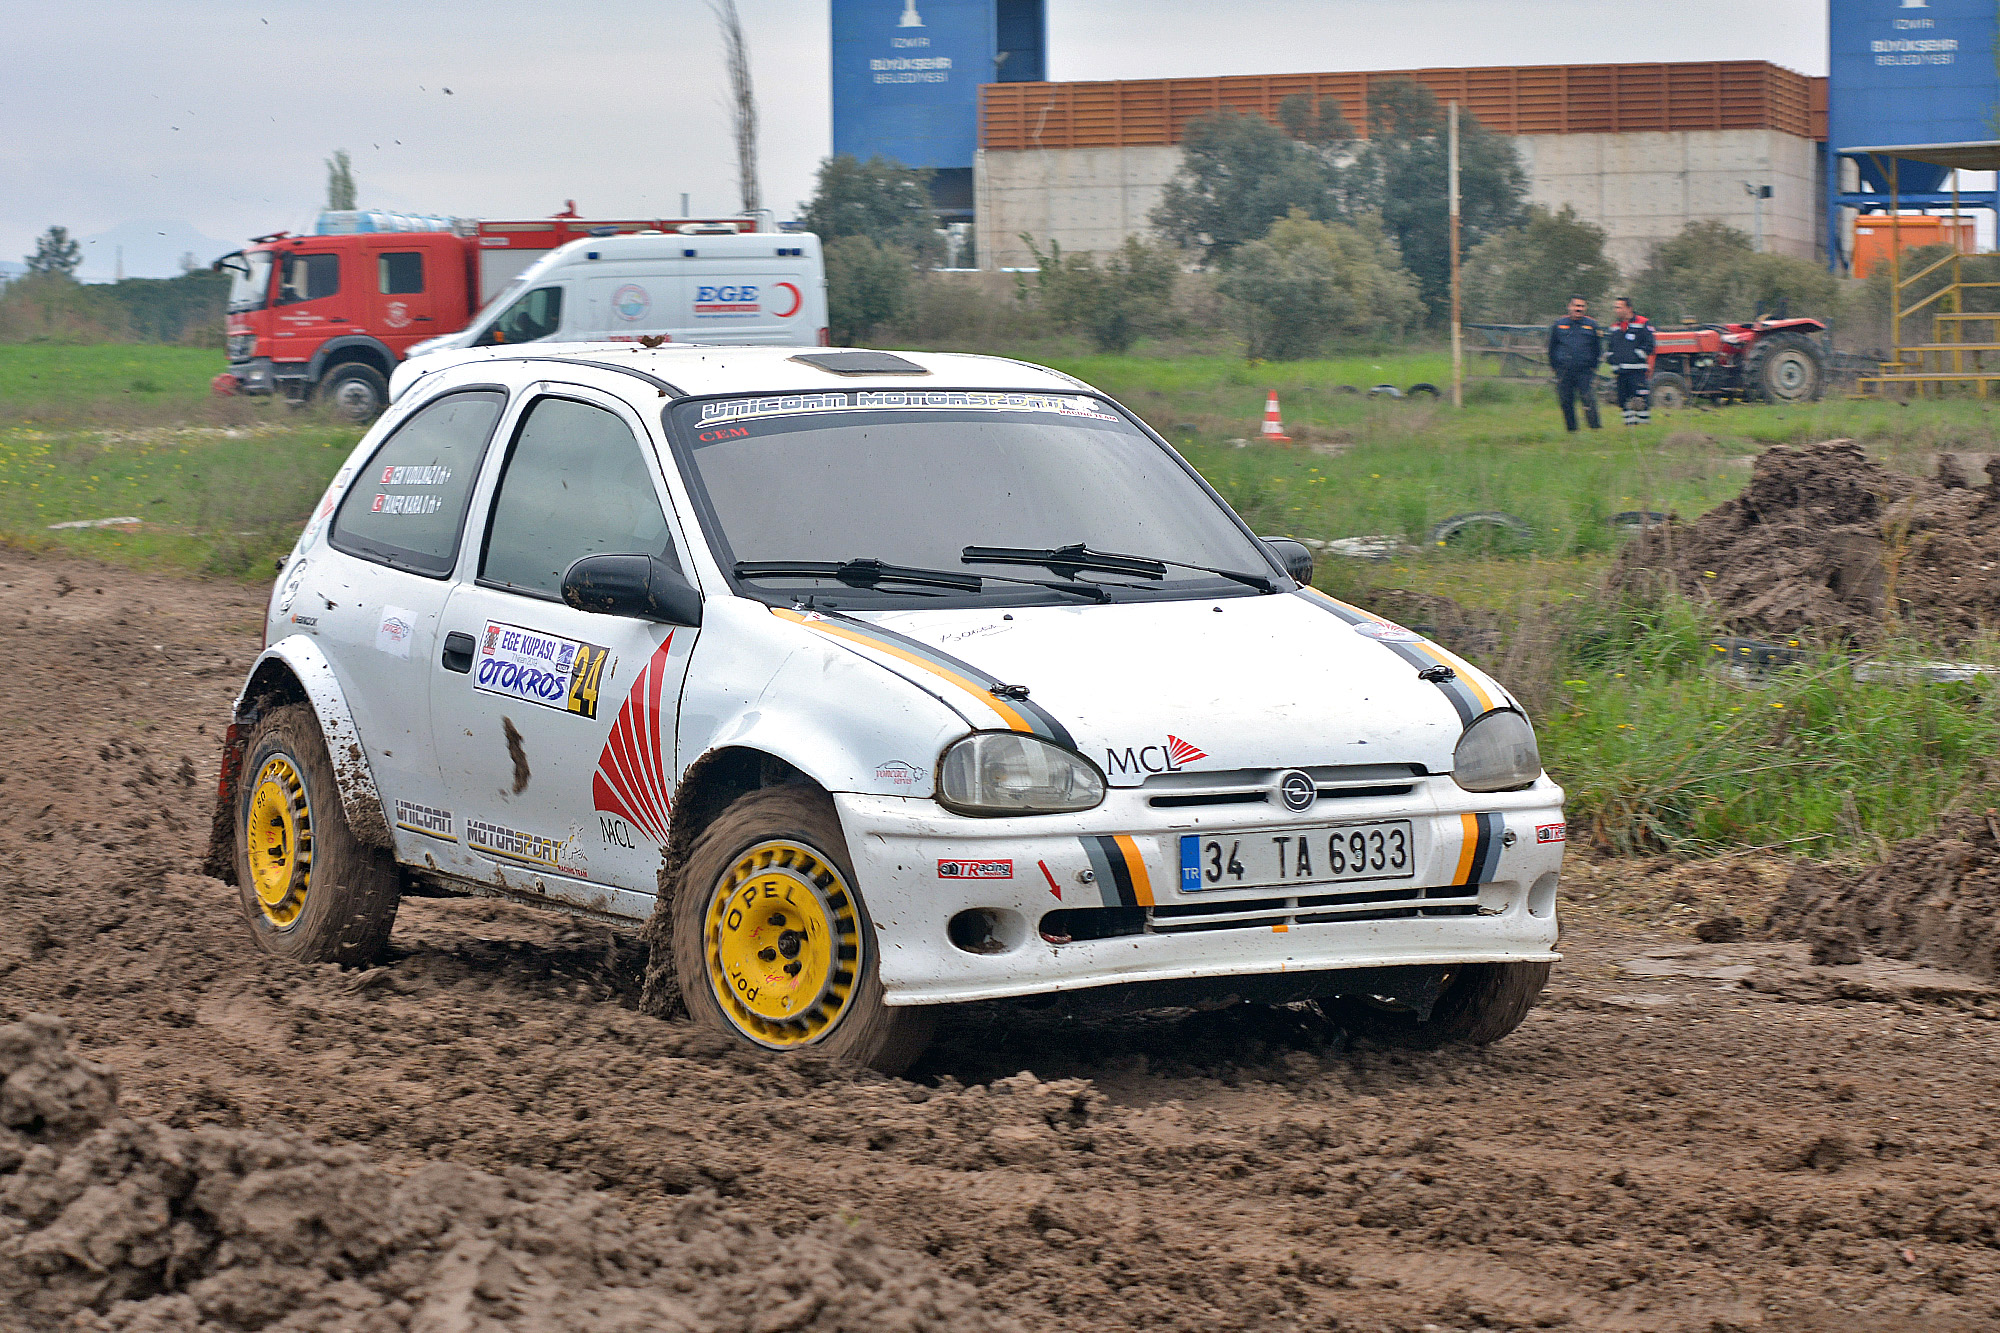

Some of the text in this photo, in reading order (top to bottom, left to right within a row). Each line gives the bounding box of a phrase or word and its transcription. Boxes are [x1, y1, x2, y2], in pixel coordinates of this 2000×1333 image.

[695, 285, 759, 302] EGE
[702, 392, 849, 420] UNICORN
[699, 426, 750, 442] CEM
[501, 630, 557, 661] EGE KUPASI
[478, 657, 568, 701] OTOKROS
[568, 645, 606, 716] 24
[1106, 745, 1182, 776] MCL
[395, 799, 563, 864] UNICORN MOTORSPORT
[599, 816, 636, 850] MCL
[1204, 828, 1407, 883] 34 TA 6933
[1183, 867, 1200, 880] TR
[727, 881, 798, 931] OPEL
